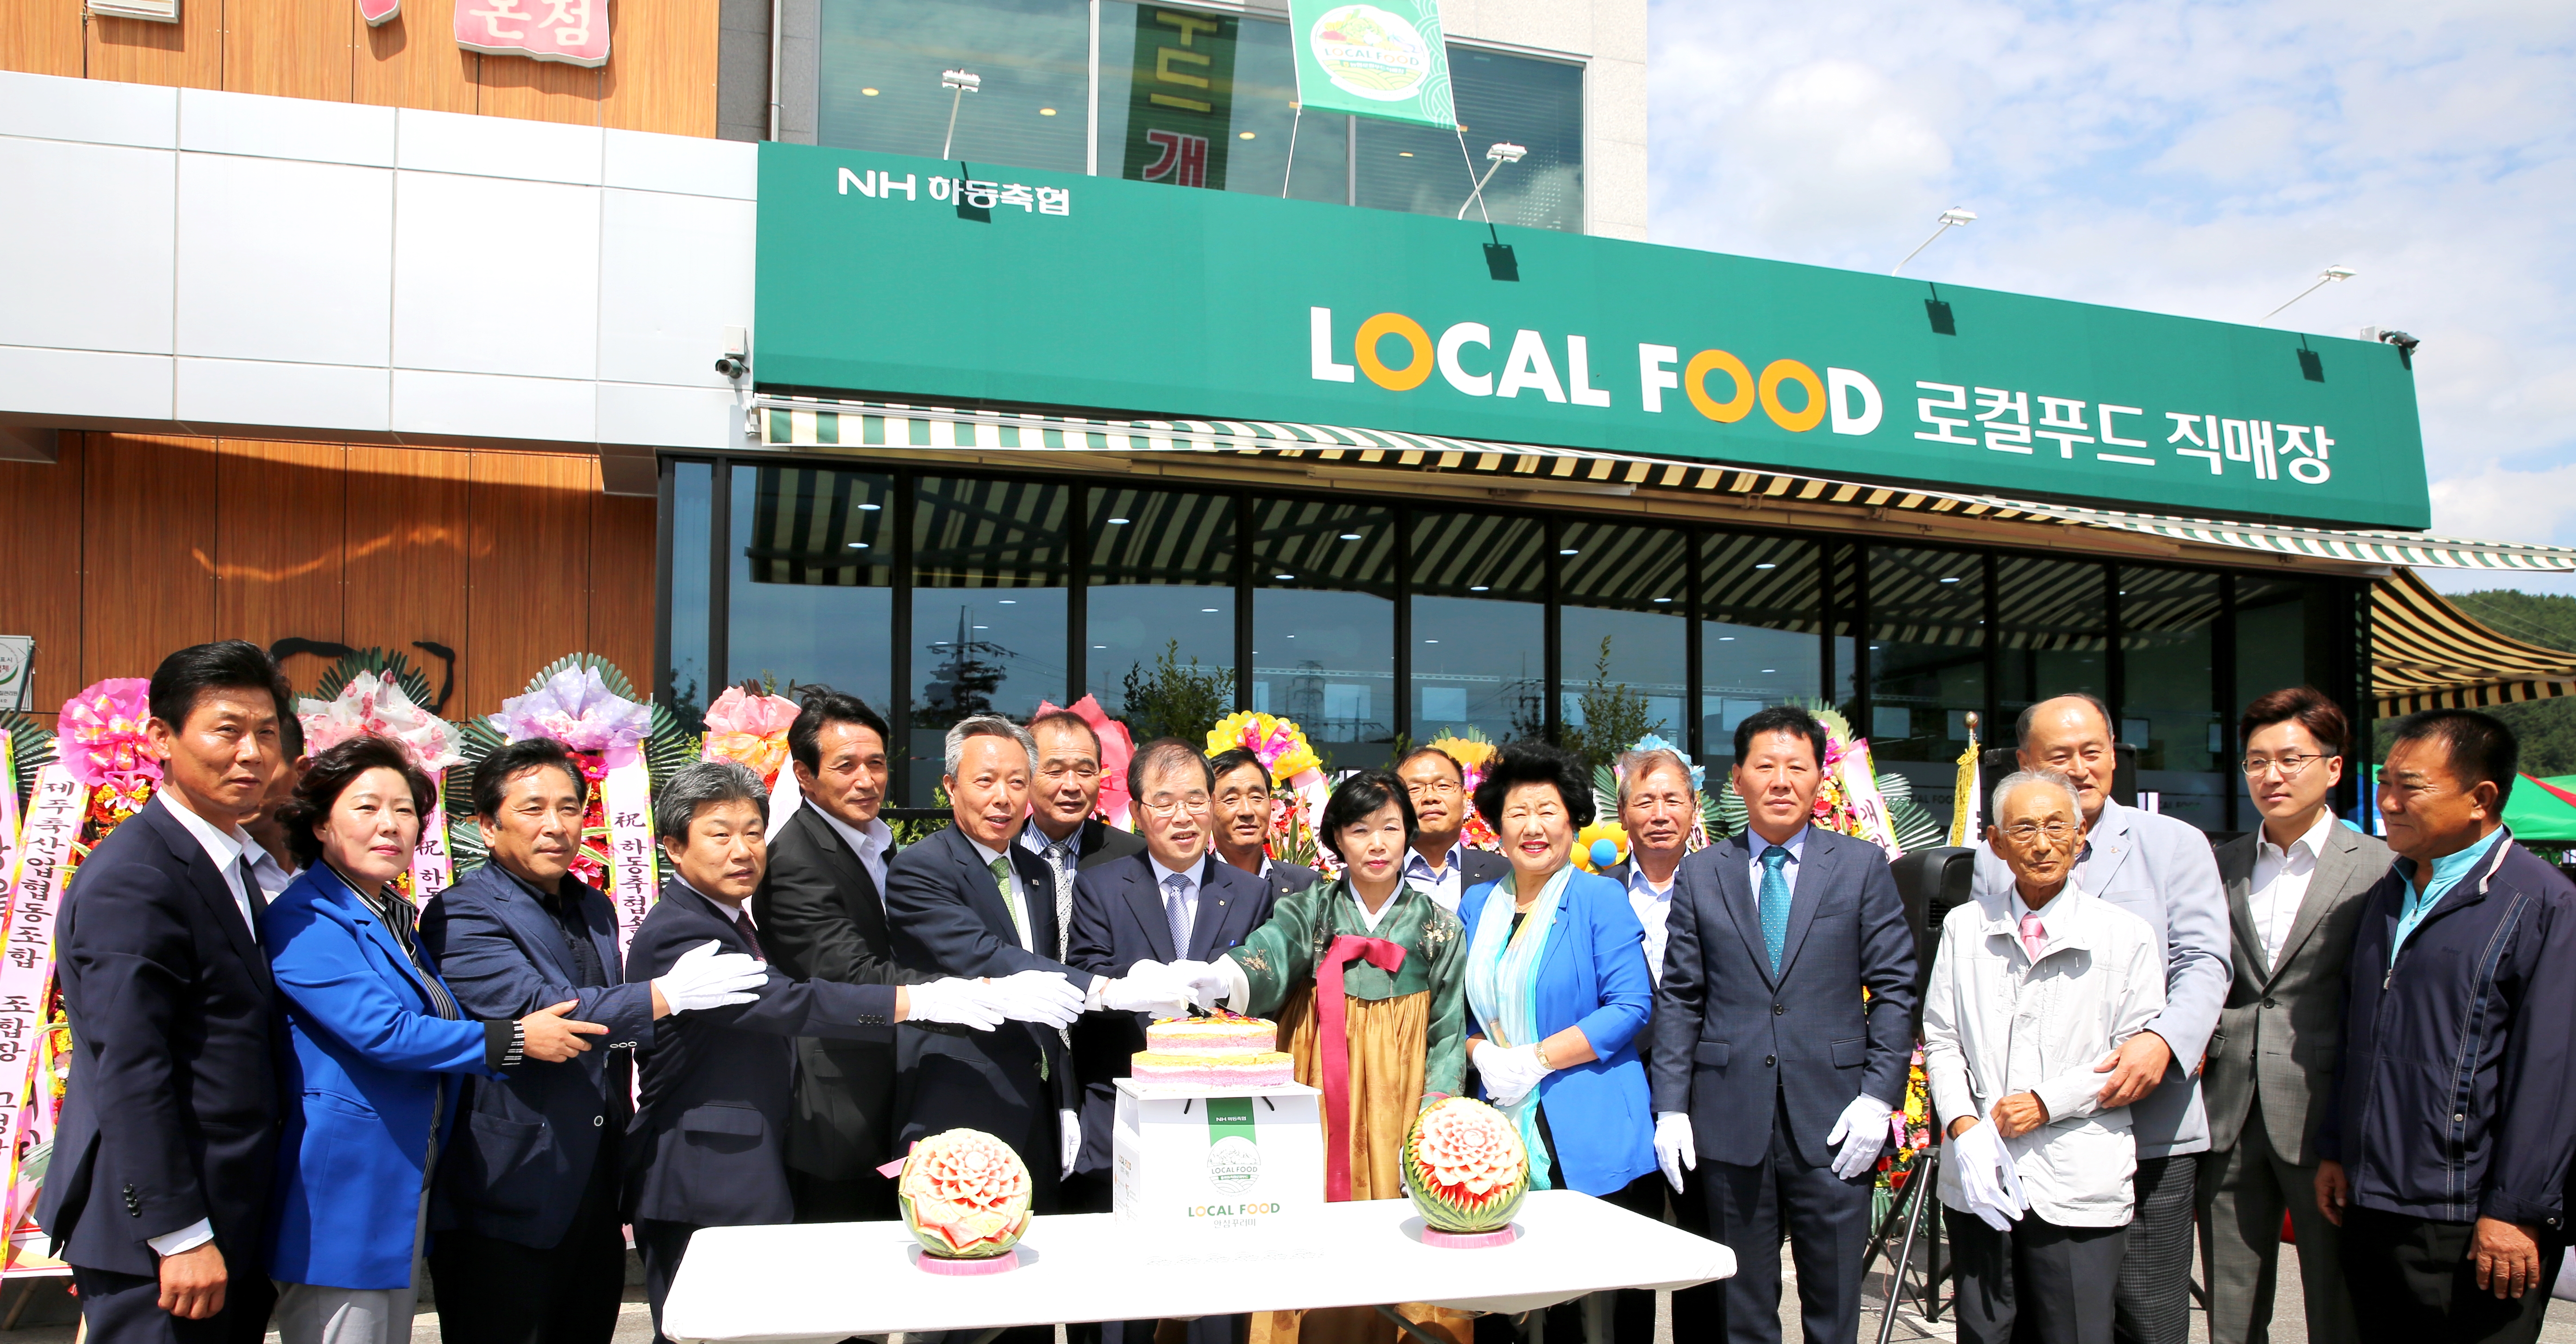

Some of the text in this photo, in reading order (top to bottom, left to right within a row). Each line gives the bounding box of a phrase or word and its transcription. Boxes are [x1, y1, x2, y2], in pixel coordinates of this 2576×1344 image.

[1324, 48, 1419, 65] LOCAL FOOD
[838, 167, 1069, 216] NH 하동축협
[1310, 306, 2335, 484] LOCAL FOOD 로컬푸드 직매장
[1911, 794, 1953, 804] CAL FOO
[614, 812, 646, 828] 祝
[0, 995, 35, 1062] 조합장
[1188, 1203, 1280, 1217] LOCAL FOOD
[1214, 1218, 1256, 1229] 안심꾸러미
